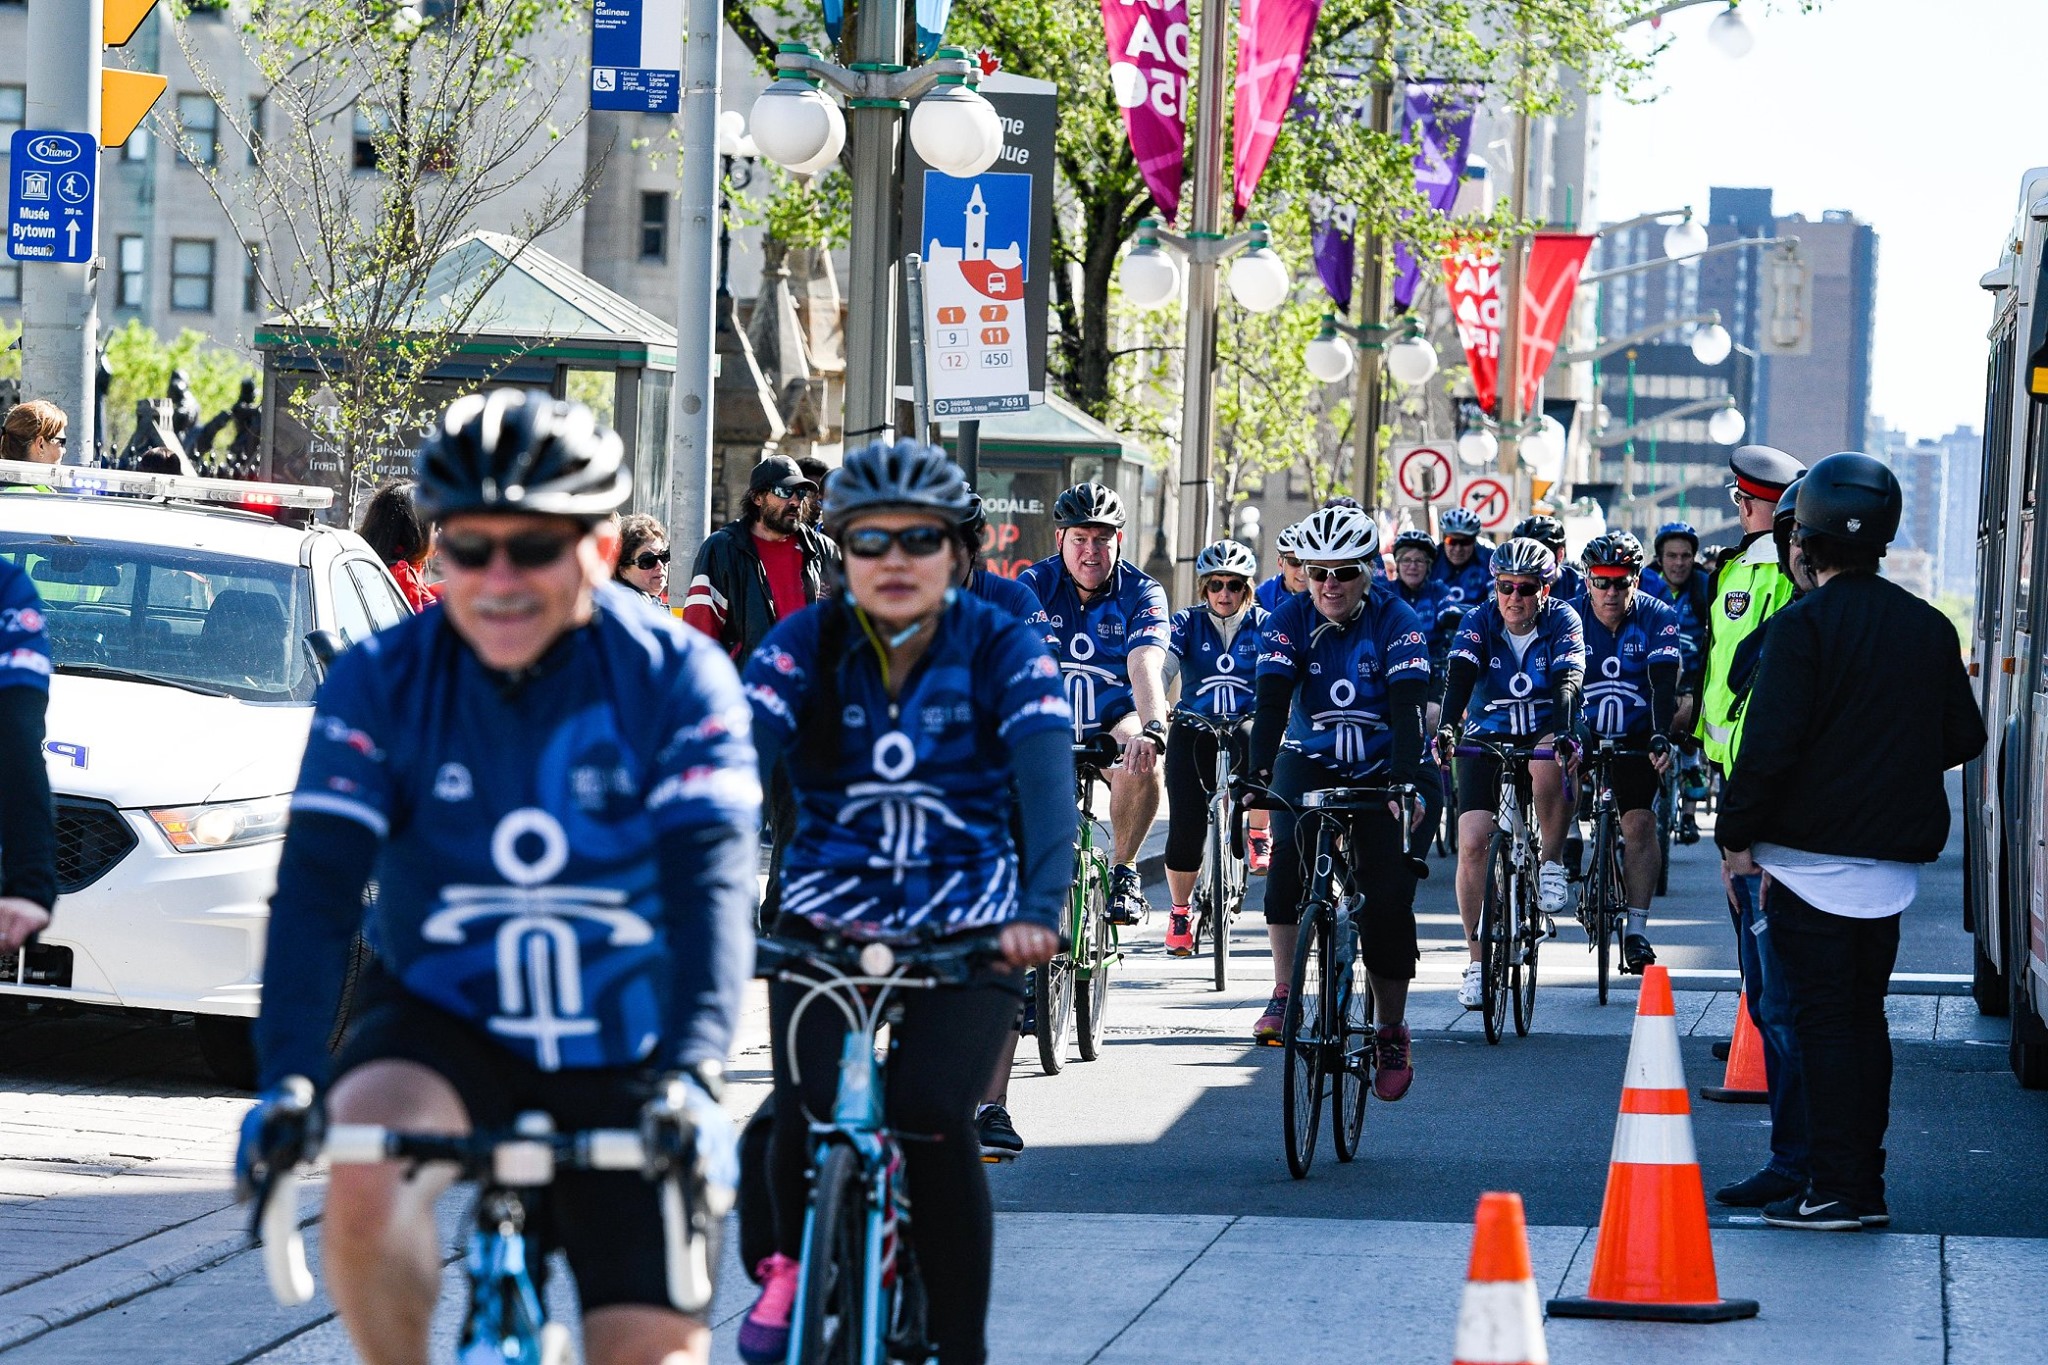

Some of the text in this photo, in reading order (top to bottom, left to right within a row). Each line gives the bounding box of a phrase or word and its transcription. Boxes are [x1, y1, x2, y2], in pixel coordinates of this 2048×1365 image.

[595, 8, 630, 17] Gatineau
[20, 206, 50, 220] Musée
[64, 207, 74, 215] 200
[12, 222, 56, 240] Bytown
[947, 309, 955, 323] 1
[989, 307, 998, 320] 7
[948, 332, 957, 345] 9
[987, 329, 1003, 343] 11
[946, 354, 962, 368] 12
[984, 352, 1009, 366] 450
[1001, 397, 1024, 408] 7691
[982, 497, 1045, 514] ODALE:
